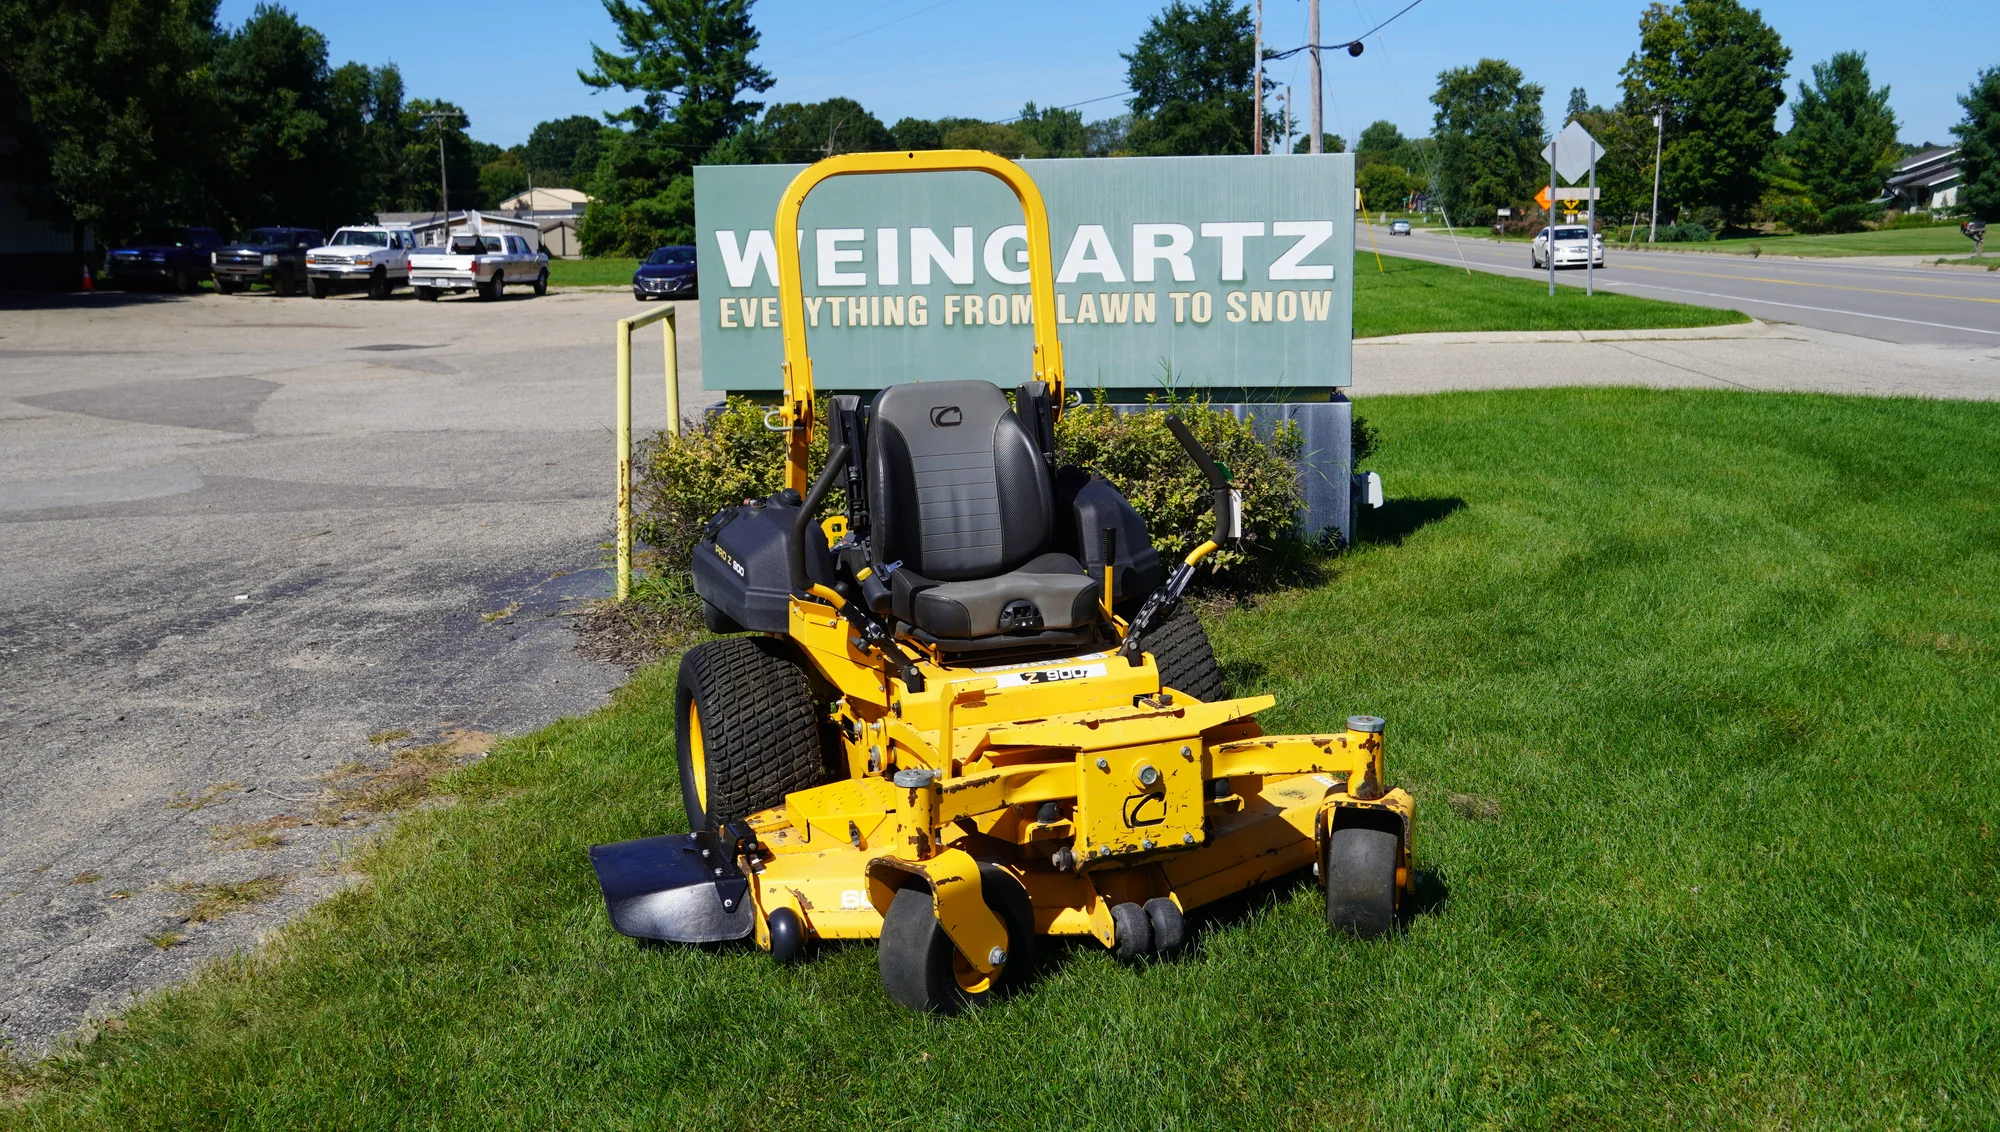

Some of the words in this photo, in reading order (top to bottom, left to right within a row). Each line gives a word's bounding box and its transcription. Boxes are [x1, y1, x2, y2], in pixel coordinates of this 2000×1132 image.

[715, 220, 1335, 288] WEINGARTZ
[719, 294, 929, 328] EVEYTHING
[1057, 292, 1156, 324] LAWN
[1169, 291, 1213, 324] TO
[1226, 290, 1333, 322] SNOW
[715, 543, 727, 561] PRO
[733, 560, 745, 577] 900
[1025, 671, 1039, 683] Z
[1046, 668, 1084, 681] 900
